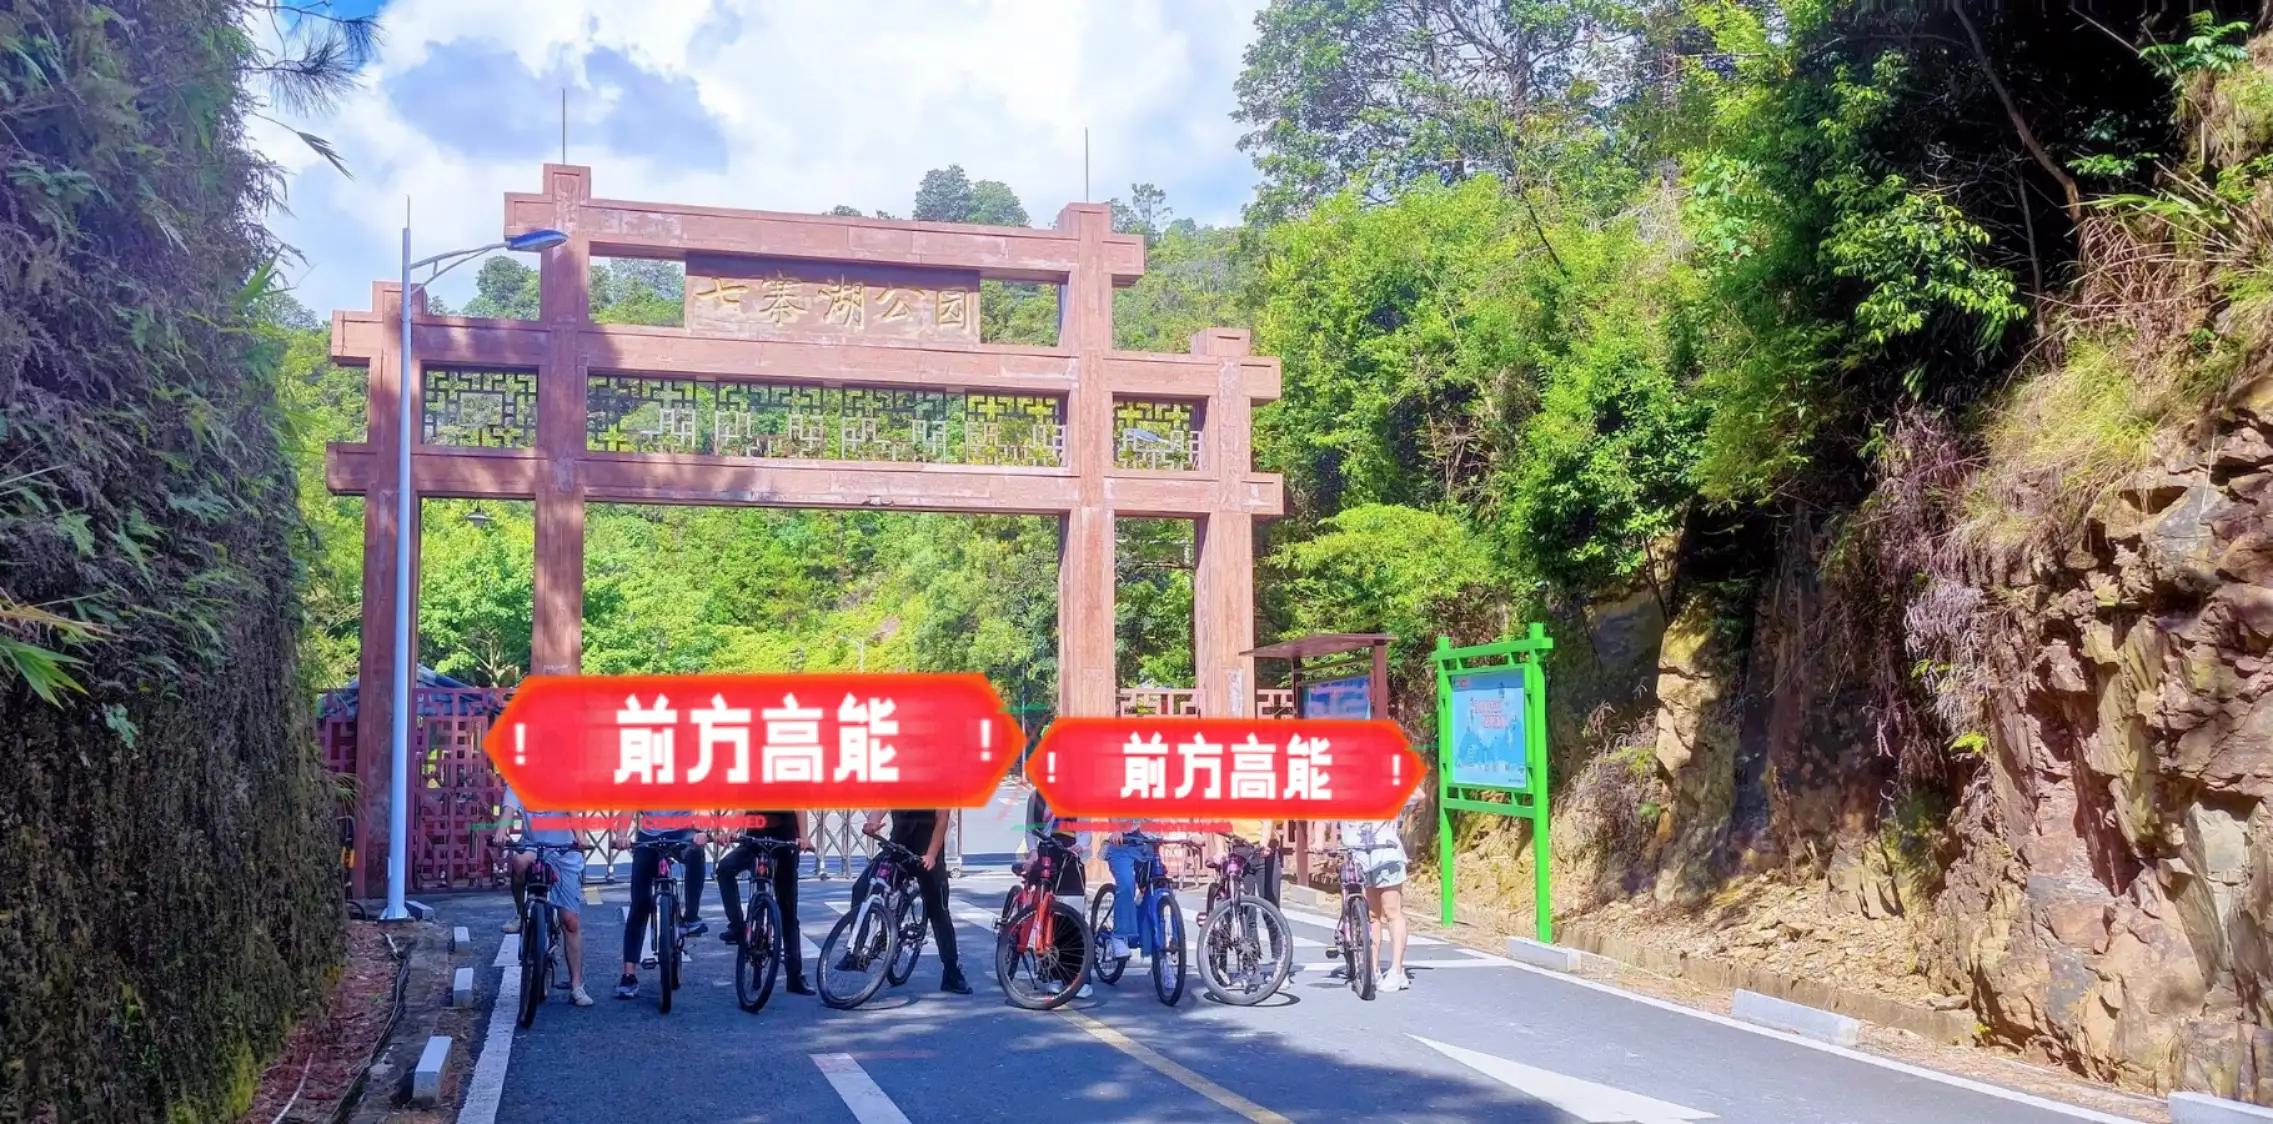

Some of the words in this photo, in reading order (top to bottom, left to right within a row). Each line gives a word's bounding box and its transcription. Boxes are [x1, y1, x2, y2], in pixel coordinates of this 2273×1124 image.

[695, 271, 971, 333] 七寨湖公园
